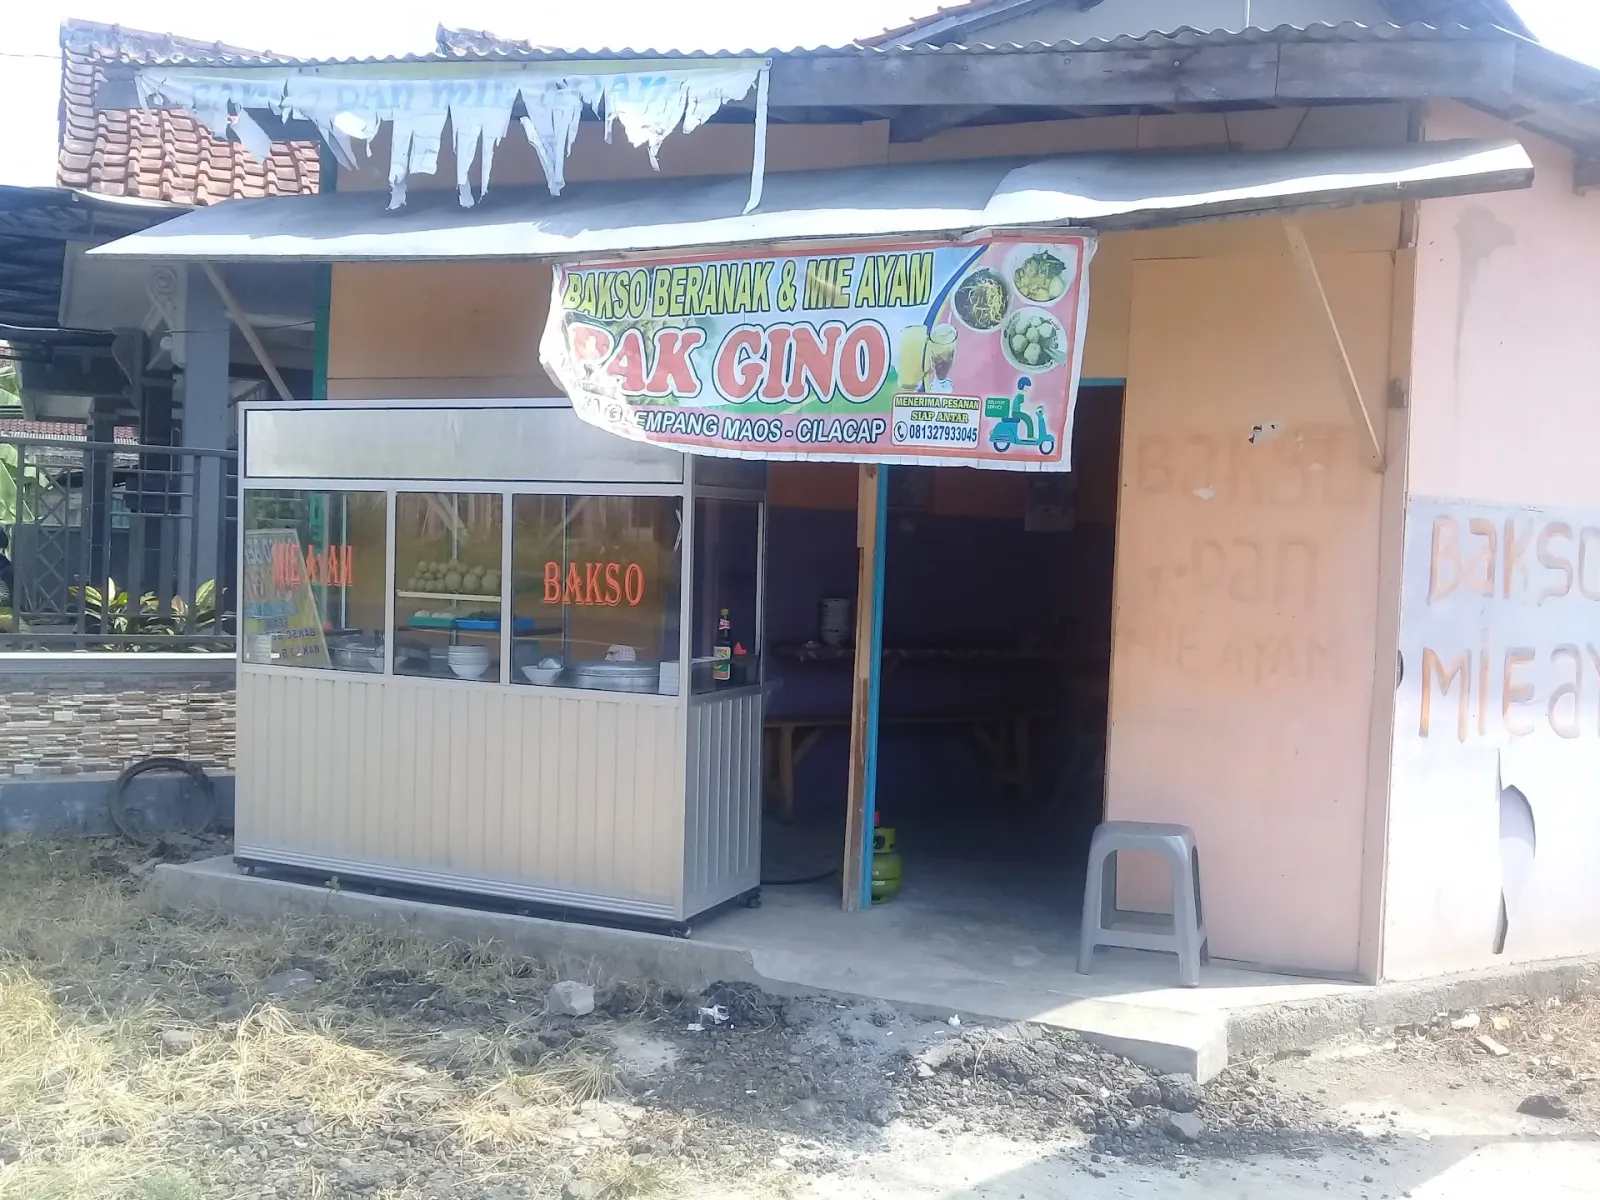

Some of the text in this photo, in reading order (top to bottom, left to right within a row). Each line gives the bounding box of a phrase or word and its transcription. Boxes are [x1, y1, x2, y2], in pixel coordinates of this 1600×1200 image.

[562, 252, 934, 318] BAKSO BERANAK & MIE AYAM
[570, 320, 889, 402] PAK GINO
[895, 397, 979, 410] MENERIMA PESANAN
[722, 417, 783, 441] MAOS
[796, 418, 886, 443] CILACAP
[911, 411, 969, 423] SIAP ANTAR
[909, 424, 977, 442] 081327933045
[543, 561, 644, 606] BAKSO
